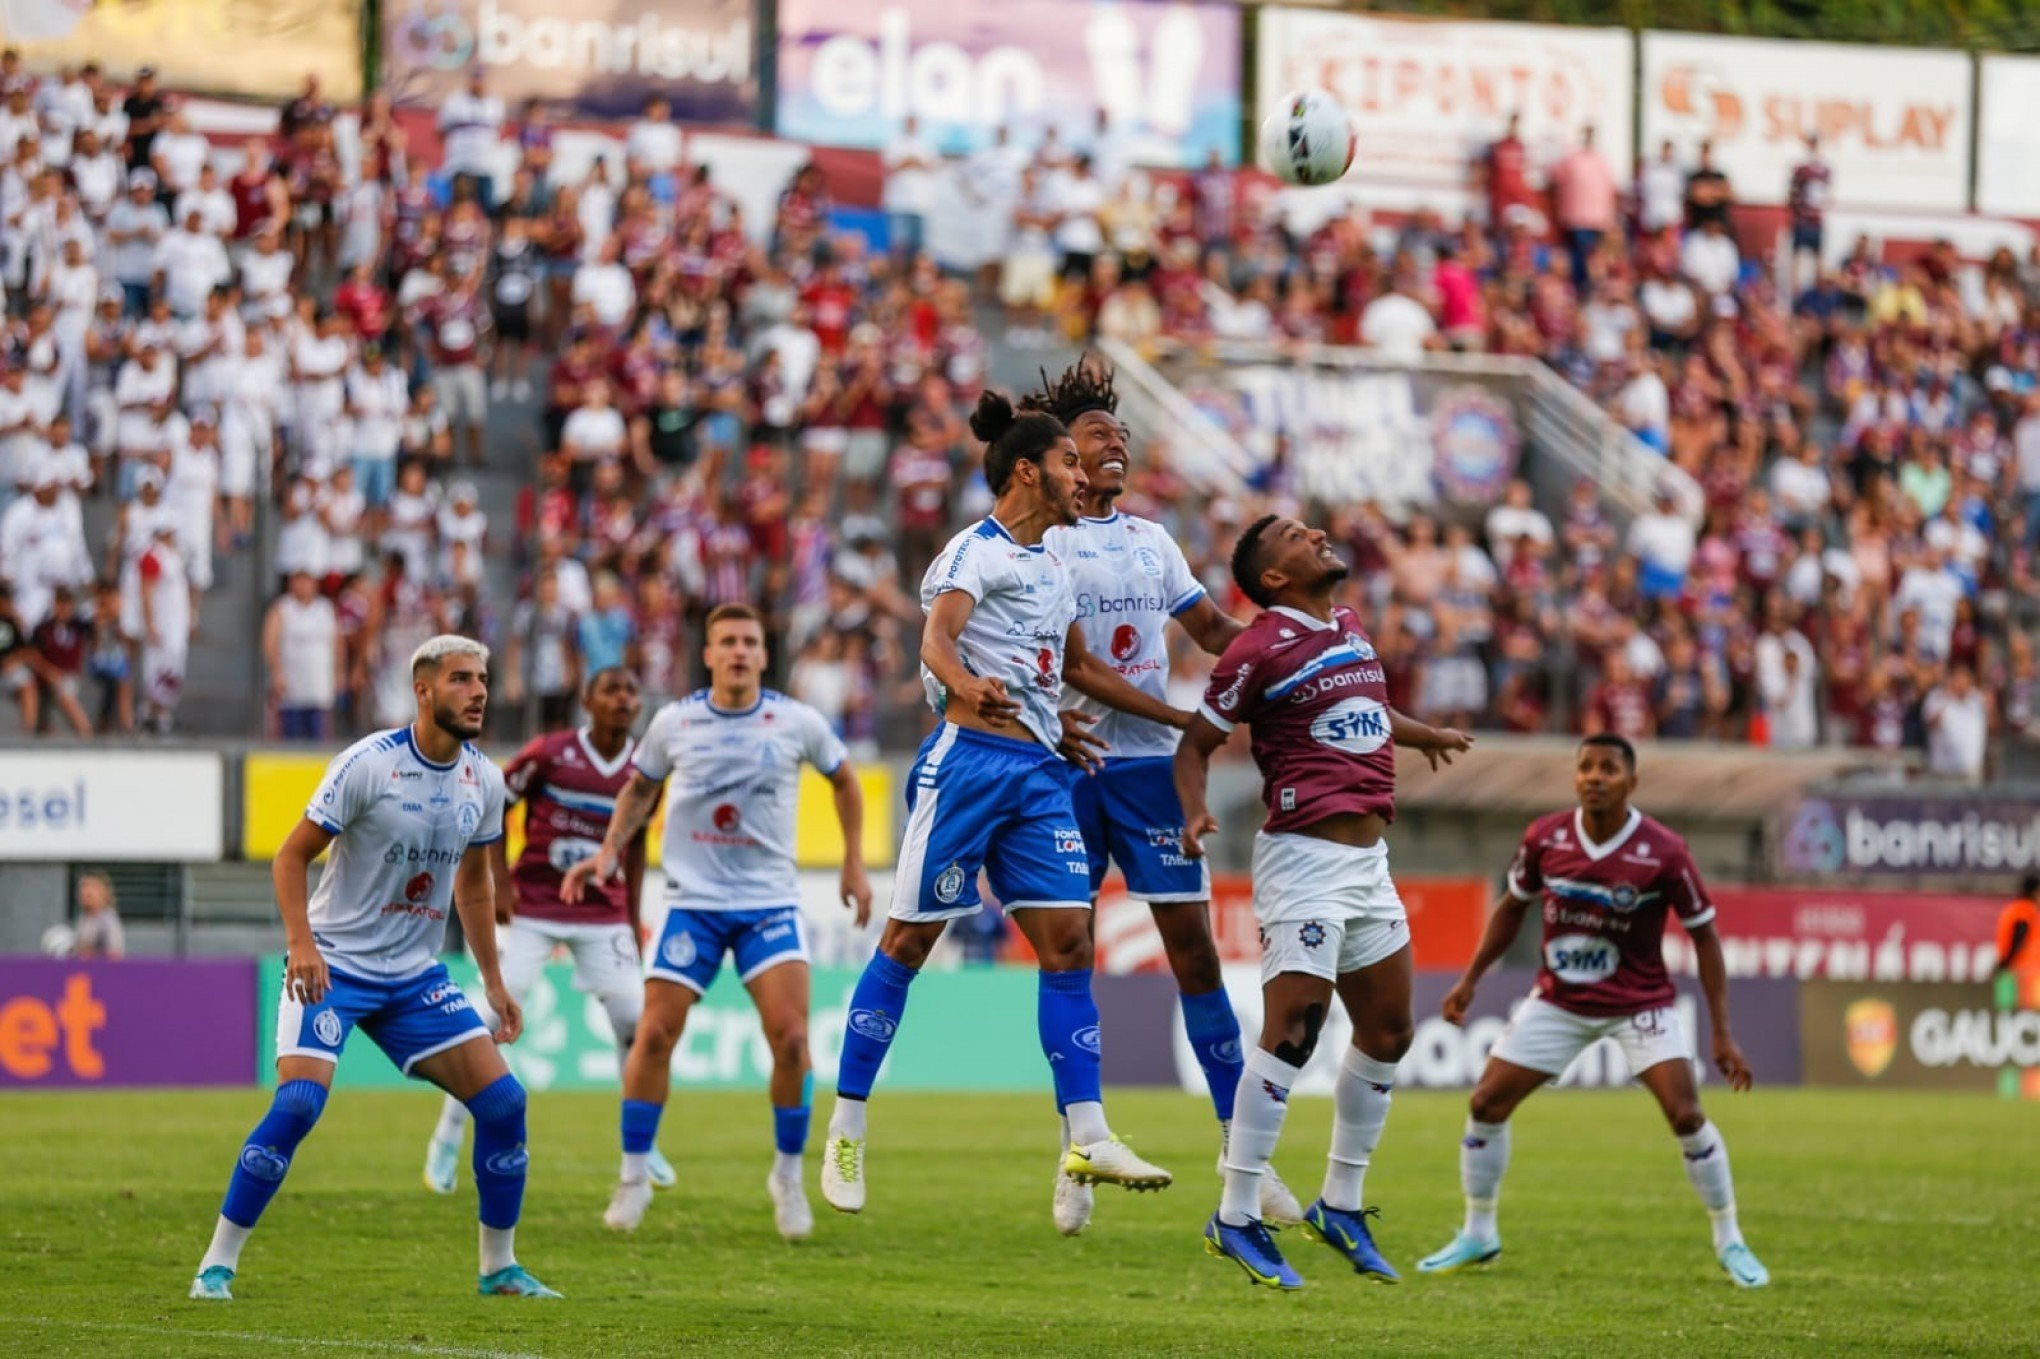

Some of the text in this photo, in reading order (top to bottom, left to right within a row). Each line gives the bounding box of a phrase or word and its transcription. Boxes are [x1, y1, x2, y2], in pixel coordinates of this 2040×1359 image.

[477, 0, 750, 83] banrisul
[811, 6, 1042, 125] elan
[1762, 95, 1956, 150] SUPLAY
